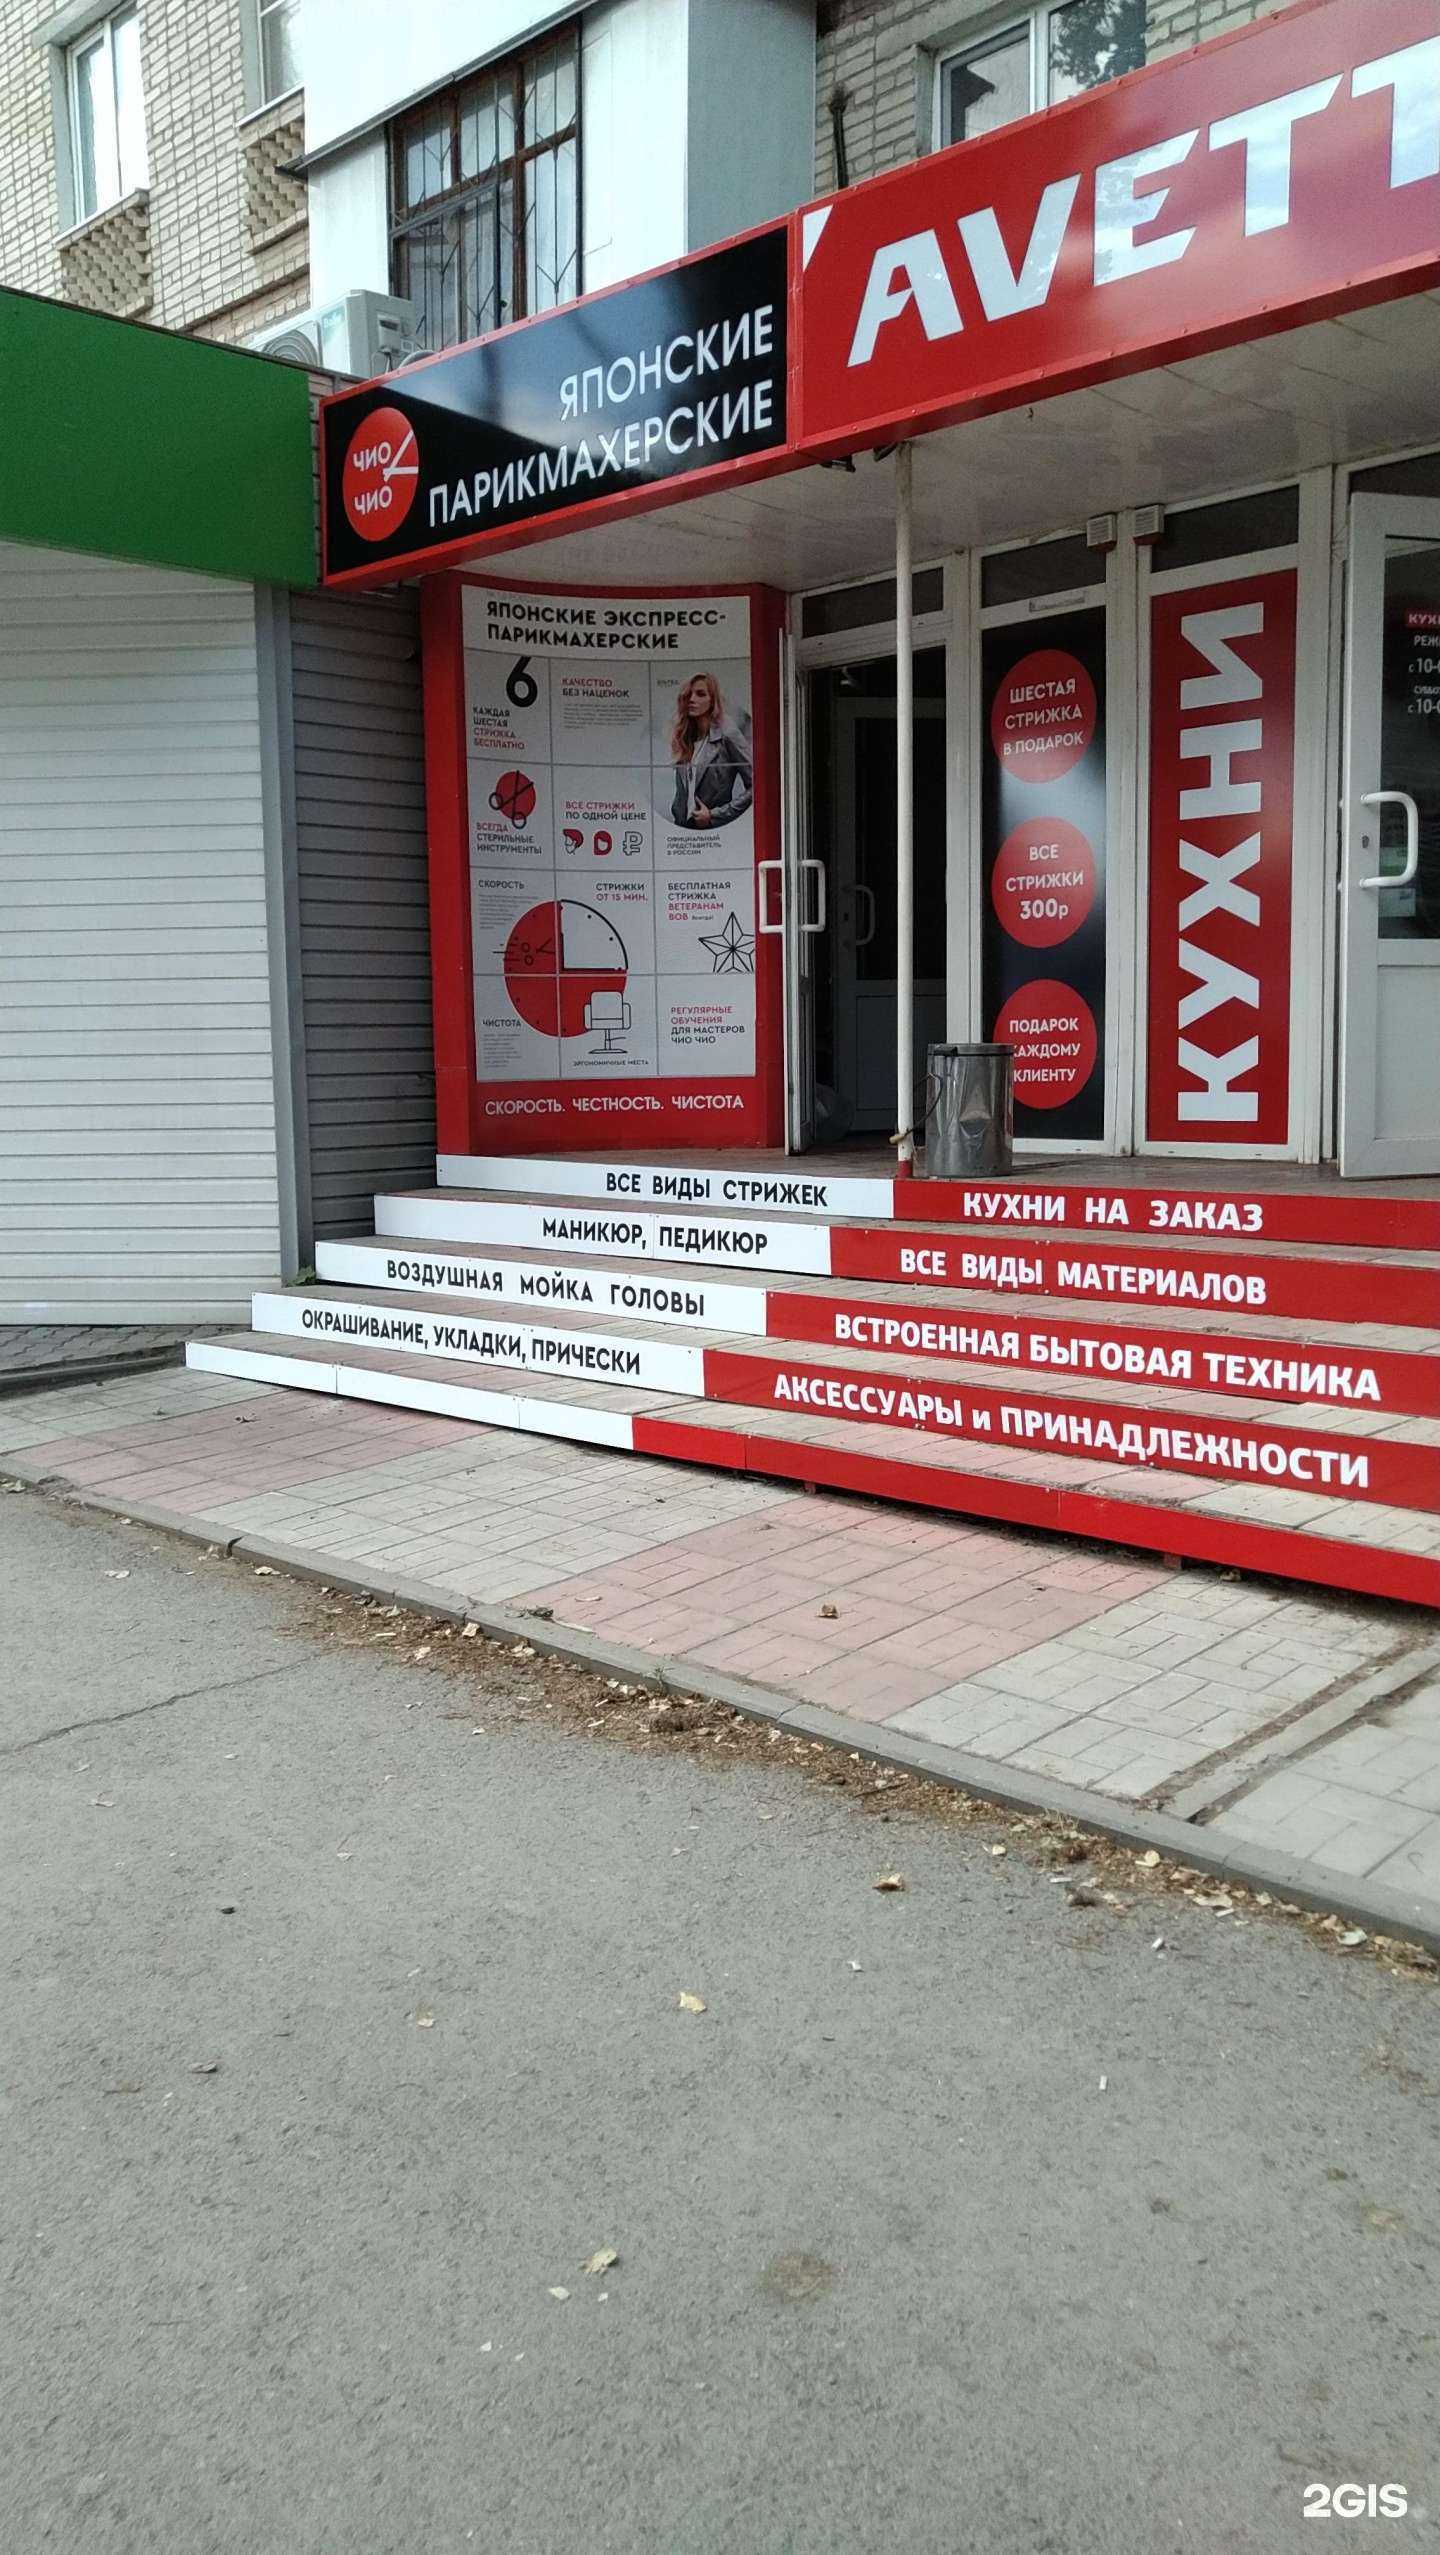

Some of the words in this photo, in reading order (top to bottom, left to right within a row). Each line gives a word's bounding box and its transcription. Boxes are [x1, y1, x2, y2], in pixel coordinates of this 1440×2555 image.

[559, 304, 773, 422] ЯПОНСКИЕ
[353, 441, 391, 472] ЧИО
[429, 379, 773, 528] ПАРИКМАХЕРСКИЕ
[354, 485, 393, 516] ЧИО
[487, 601, 596, 626] ЯПОНСКИЕ
[604, 609, 726, 627] ЭКСПРЕСС-
[1408, 613, 1440, 625] КУХ
[488, 623, 679, 649] ПАРИКМАХЕРСКИЕ
[1413, 634, 1440, 647] РЕЖ
[506, 655, 538, 708] 6
[561, 678, 613, 688] КАЧЕСТВО
[562, 688, 579, 697] БЕЗ
[582, 689, 630, 699] НАЦЕНОК
[1009, 678, 1076, 704] ШЕСТАЯ
[473, 706, 510, 717] КАЖДАЯ
[1004, 704, 1083, 730] СТРИЖКА
[473, 716, 508, 727] ШЕСТАЯ
[474, 727, 516, 738] СТРИЖКА
[474, 738, 525, 750] БЕСПЛАТНО
[1003, 742, 1011, 756] В
[1015, 730, 1084, 754] ПОДАРОК
[565, 801, 583, 809] ВСЕ
[586, 801, 635, 810] СТРИЖКИ
[565, 811, 580, 820] ПО
[582, 810, 618, 821] ОДНОЙ
[621, 812, 647, 822] ЦЕНЕ
[476, 822, 509, 832] ВСЕГДА
[476, 832, 535, 844] СТЕРИЛЬНЫЕ
[476, 843, 542, 855] ИНСТРУМЕНТЫ
[1029, 844, 1059, 861] ВСЕ
[1177, 601, 1264, 1122] КУХНИ
[478, 880, 525, 890] СКОРОСТЬ
[596, 882, 645, 891] СТРИЖКИ
[668, 881, 731, 891] БЕСПЛАТНАЯ
[1005, 871, 1084, 892] СТРИЖКИ
[596, 892, 609, 901] ОТ
[612, 892, 621, 901] 15
[668, 892, 717, 901] СТРИЖКА
[668, 902, 724, 911] ВЕТЕРАНАМ
[1020, 898, 1068, 919] 300р
[668, 912, 688, 920] ВОВ
[671, 1005, 733, 1015] РЕГУЛЯРНЫЕ
[483, 1018, 522, 1028] ЧИСТОТА
[671, 1015, 723, 1025] ОБУЧЕНИЯ
[1009, 1018, 1078, 1034] ПОДАРОК
[671, 1025, 692, 1035] ДЛЯ
[694, 1025, 746, 1035] МАСТЕРОВ
[671, 1036, 692, 1045] ЧИО
[695, 1035, 717, 1045] ЧИО
[1013, 1043, 1081, 1058] АЖДОМУ
[485, 1099, 565, 1115] СКОРОСТЬ.
[573, 1096, 664, 1112] ЧЕСТНОСТЬ.
[672, 1094, 744, 1110] ЧИСТОТА
[606, 1172, 641, 1193] ВСЕ
[652, 1175, 710, 1201] ВИДЫ
[723, 1179, 828, 1207] СТРИЖЕК
[963, 1191, 1065, 1222] КУХНИ
[1085, 1197, 1130, 1225] НА
[1149, 1200, 1264, 1232] ЗАКАЗ
[543, 1216, 647, 1250] МАНИКЮР,
[659, 1226, 768, 1254] ПЕДИКЮР
[900, 1248, 946, 1277] ВСЕ
[961, 1253, 1043, 1289] ВИДЫ
[1057, 1260, 1267, 1305] МАТЕРИАЛОВ
[387, 1259, 503, 1292] ВОЗДУШНАЯ
[520, 1271, 594, 1302] МОЙКА
[610, 1284, 705, 1316] ГОЛОВЫ
[302, 1308, 429, 1350] ОКРАШИВАНИЕ,
[433, 1325, 527, 1363] УКЛАДКИ,
[532, 1338, 641, 1375] ПРИЧЕСКИ
[835, 1313, 1020, 1360] ВСТРОЕННАЯ
[1030, 1334, 1192, 1379] БЫТОВАЯ
[1202, 1352, 1382, 1401] ТЕХНИКА
[773, 1374, 963, 1427] АКСЕССУАРЫ
[971, 1408, 992, 1431] и
[1001, 1406, 1369, 1489] ПРИНАДЛЕЖНОСТИ
